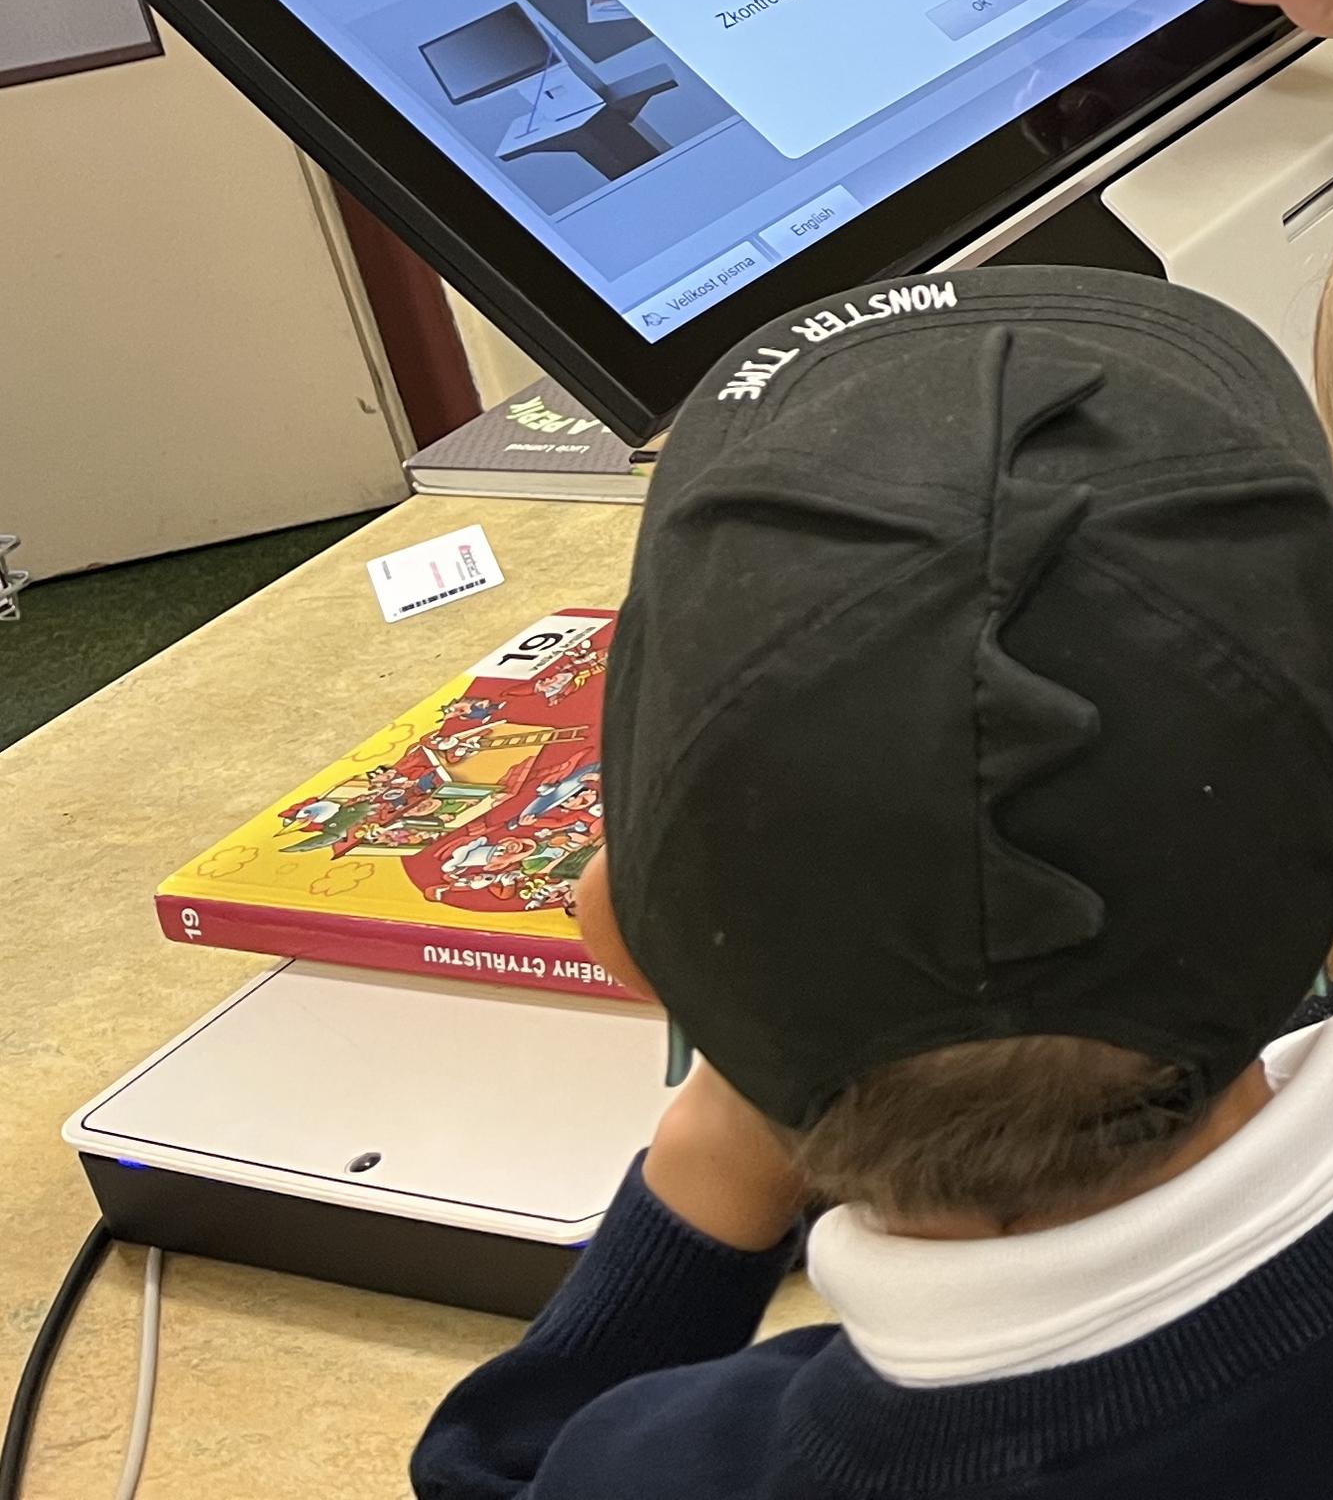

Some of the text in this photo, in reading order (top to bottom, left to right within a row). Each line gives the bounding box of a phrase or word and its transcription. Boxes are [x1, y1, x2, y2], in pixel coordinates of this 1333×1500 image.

[789, 205, 836, 238] English
[667, 277, 720, 314] Velikost
[791, 280, 959, 343] MONSTER
[717, 346, 801, 402] TIME
[497, 628, 577, 667] 19.
[181, 907, 202, 940] 19
[423, 945, 627, 988] ÍBĚHY ČTYŘLÍSTKU
